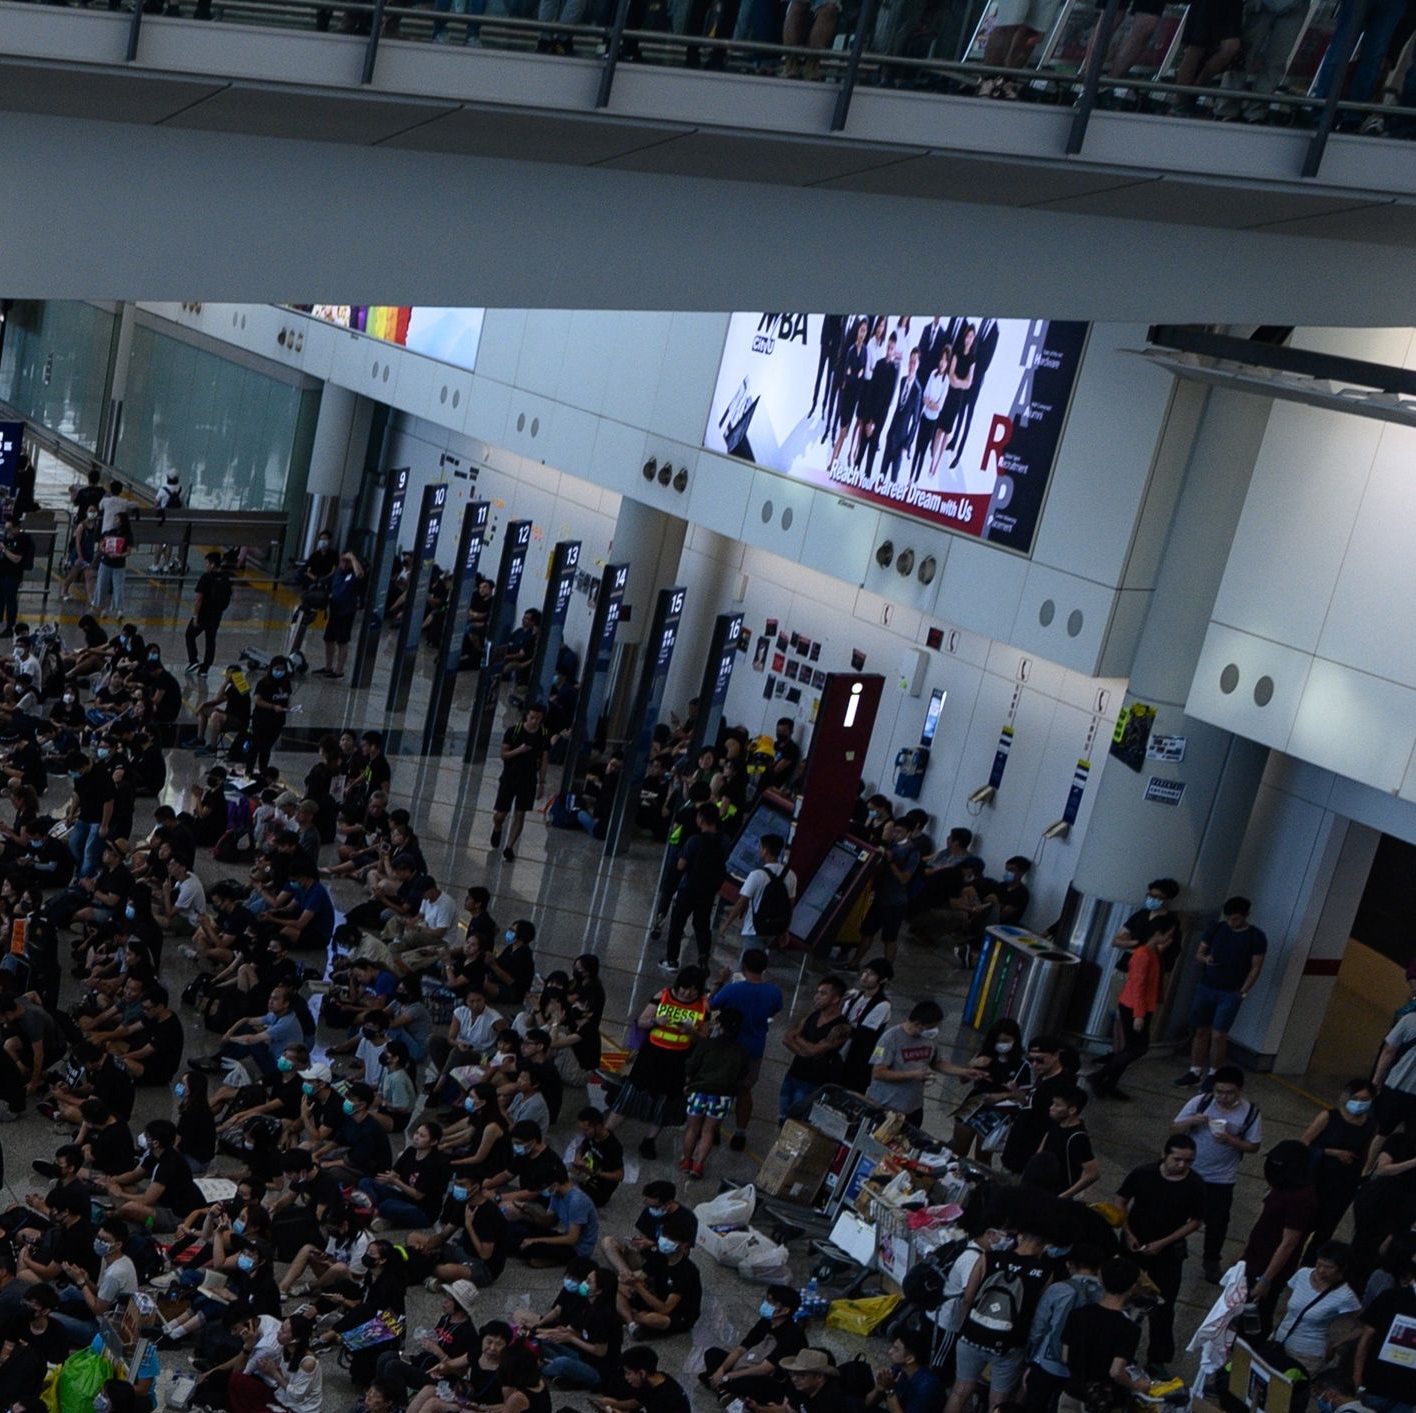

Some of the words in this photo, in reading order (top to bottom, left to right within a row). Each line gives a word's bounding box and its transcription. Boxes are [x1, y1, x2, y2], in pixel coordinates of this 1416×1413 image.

[398, 472, 406, 489] 9
[434, 488, 445, 505] 10
[830, 459, 859, 486] Reach
[874, 473, 909, 501] Career
[907, 483, 941, 513] Dream
[940, 501, 958, 518] with
[958, 498, 973, 523] Us
[476, 507, 487, 523] 11
[518, 525, 529, 544] 12
[566, 547, 579, 566] 13
[615, 568, 627, 589] 14
[671, 593, 684, 613] 15
[728, 618, 742, 640] 16
[658, 1004, 696, 1024] PRESS
